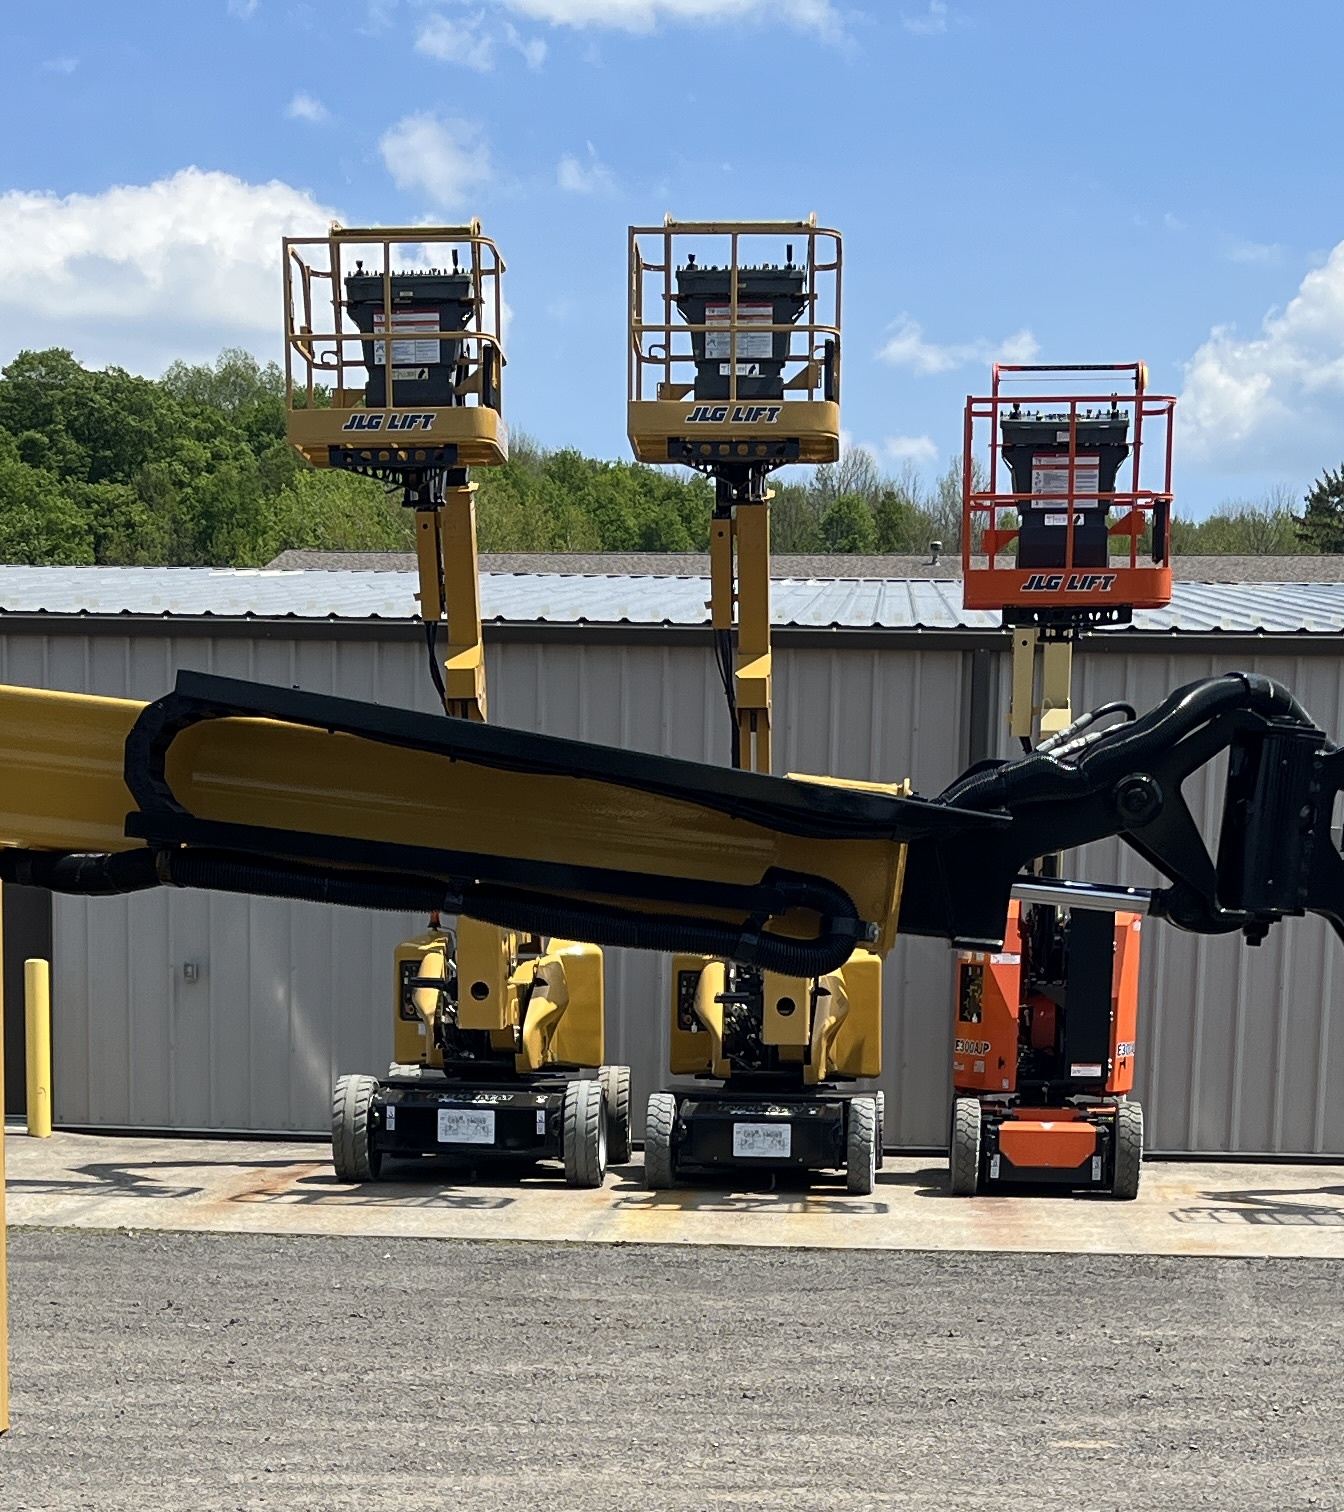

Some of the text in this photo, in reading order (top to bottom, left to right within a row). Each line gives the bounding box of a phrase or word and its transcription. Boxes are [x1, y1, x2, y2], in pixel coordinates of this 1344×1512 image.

[342, 413, 437, 431] JLG LIFT
[685, 405, 783, 423] JLG LIFT
[1020, 574, 1117, 592] JLG LIFT
